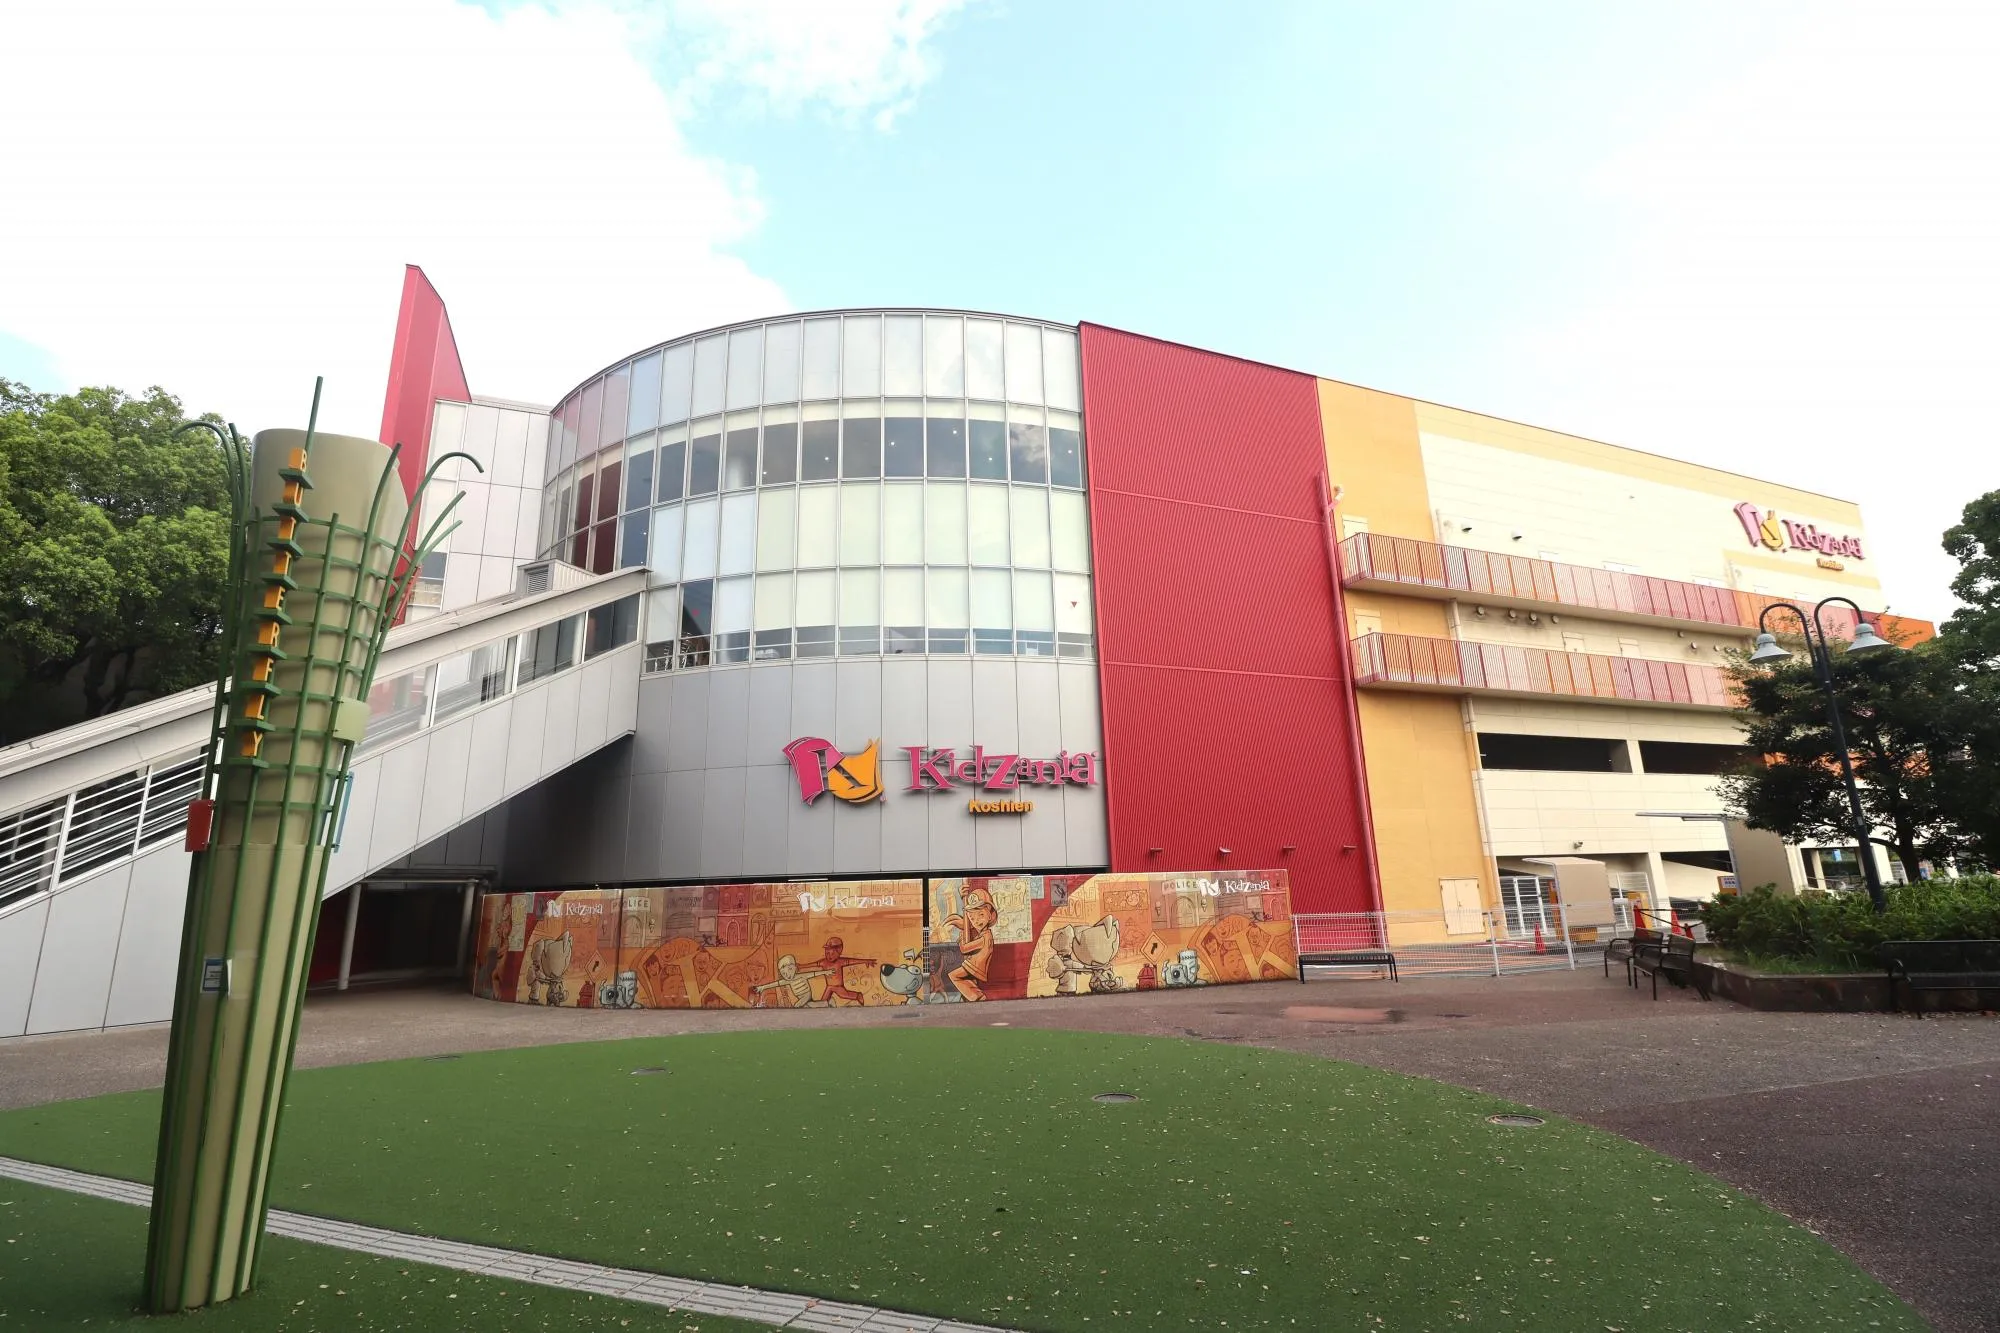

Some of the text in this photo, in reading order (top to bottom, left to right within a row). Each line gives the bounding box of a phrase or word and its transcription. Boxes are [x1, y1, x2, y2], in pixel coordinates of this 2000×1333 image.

[242, 447, 307, 757] BUTTERFLY
[898, 744, 1099, 792] KidZania
[968, 798, 1034, 816] Koshien
